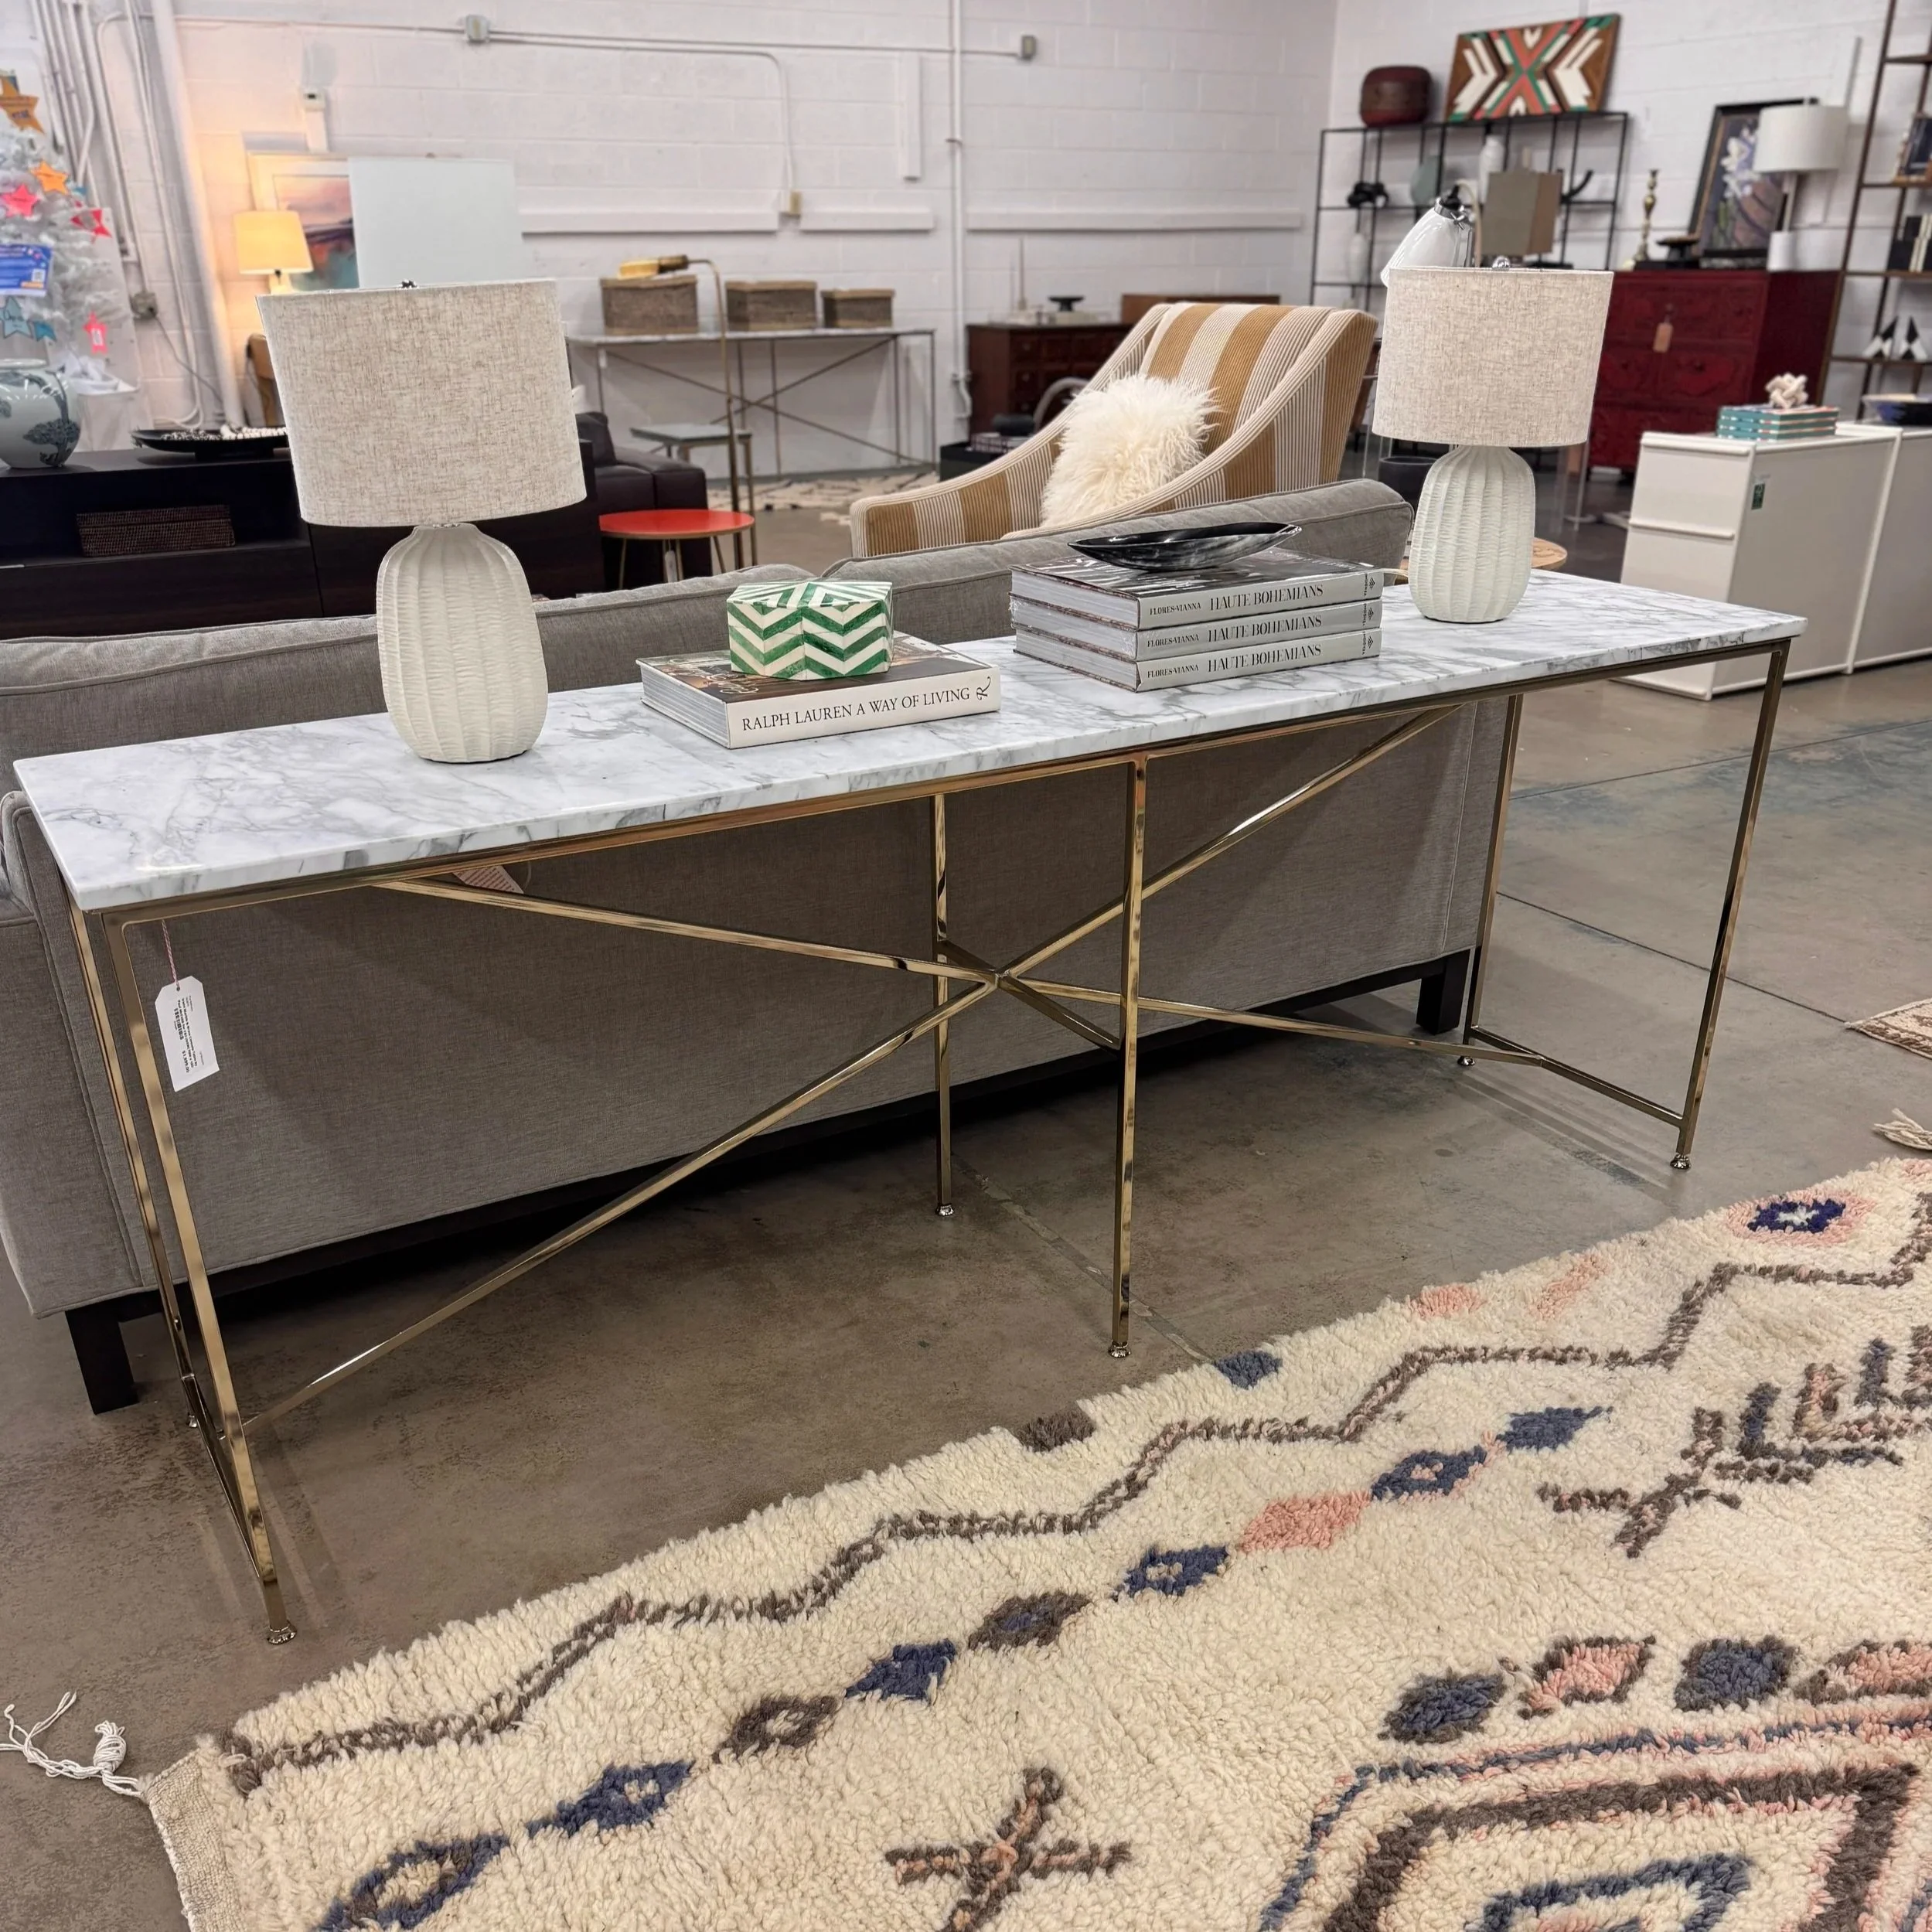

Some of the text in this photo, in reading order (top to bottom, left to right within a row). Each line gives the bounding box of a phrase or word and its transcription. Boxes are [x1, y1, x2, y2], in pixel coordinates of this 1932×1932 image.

[1150, 584, 1324, 615] FLORES-VIANNA HAUTE BOHEMIANS
[1147, 615, 1322, 647] FLORES-VIANNA HAUTE BOHEMIANS
[1147, 644, 1321, 678] FLORES-VIANNA HAUTE BOHEMIANS
[742, 687, 969, 731] RALPH LAUREN A WAY OF LIVING
